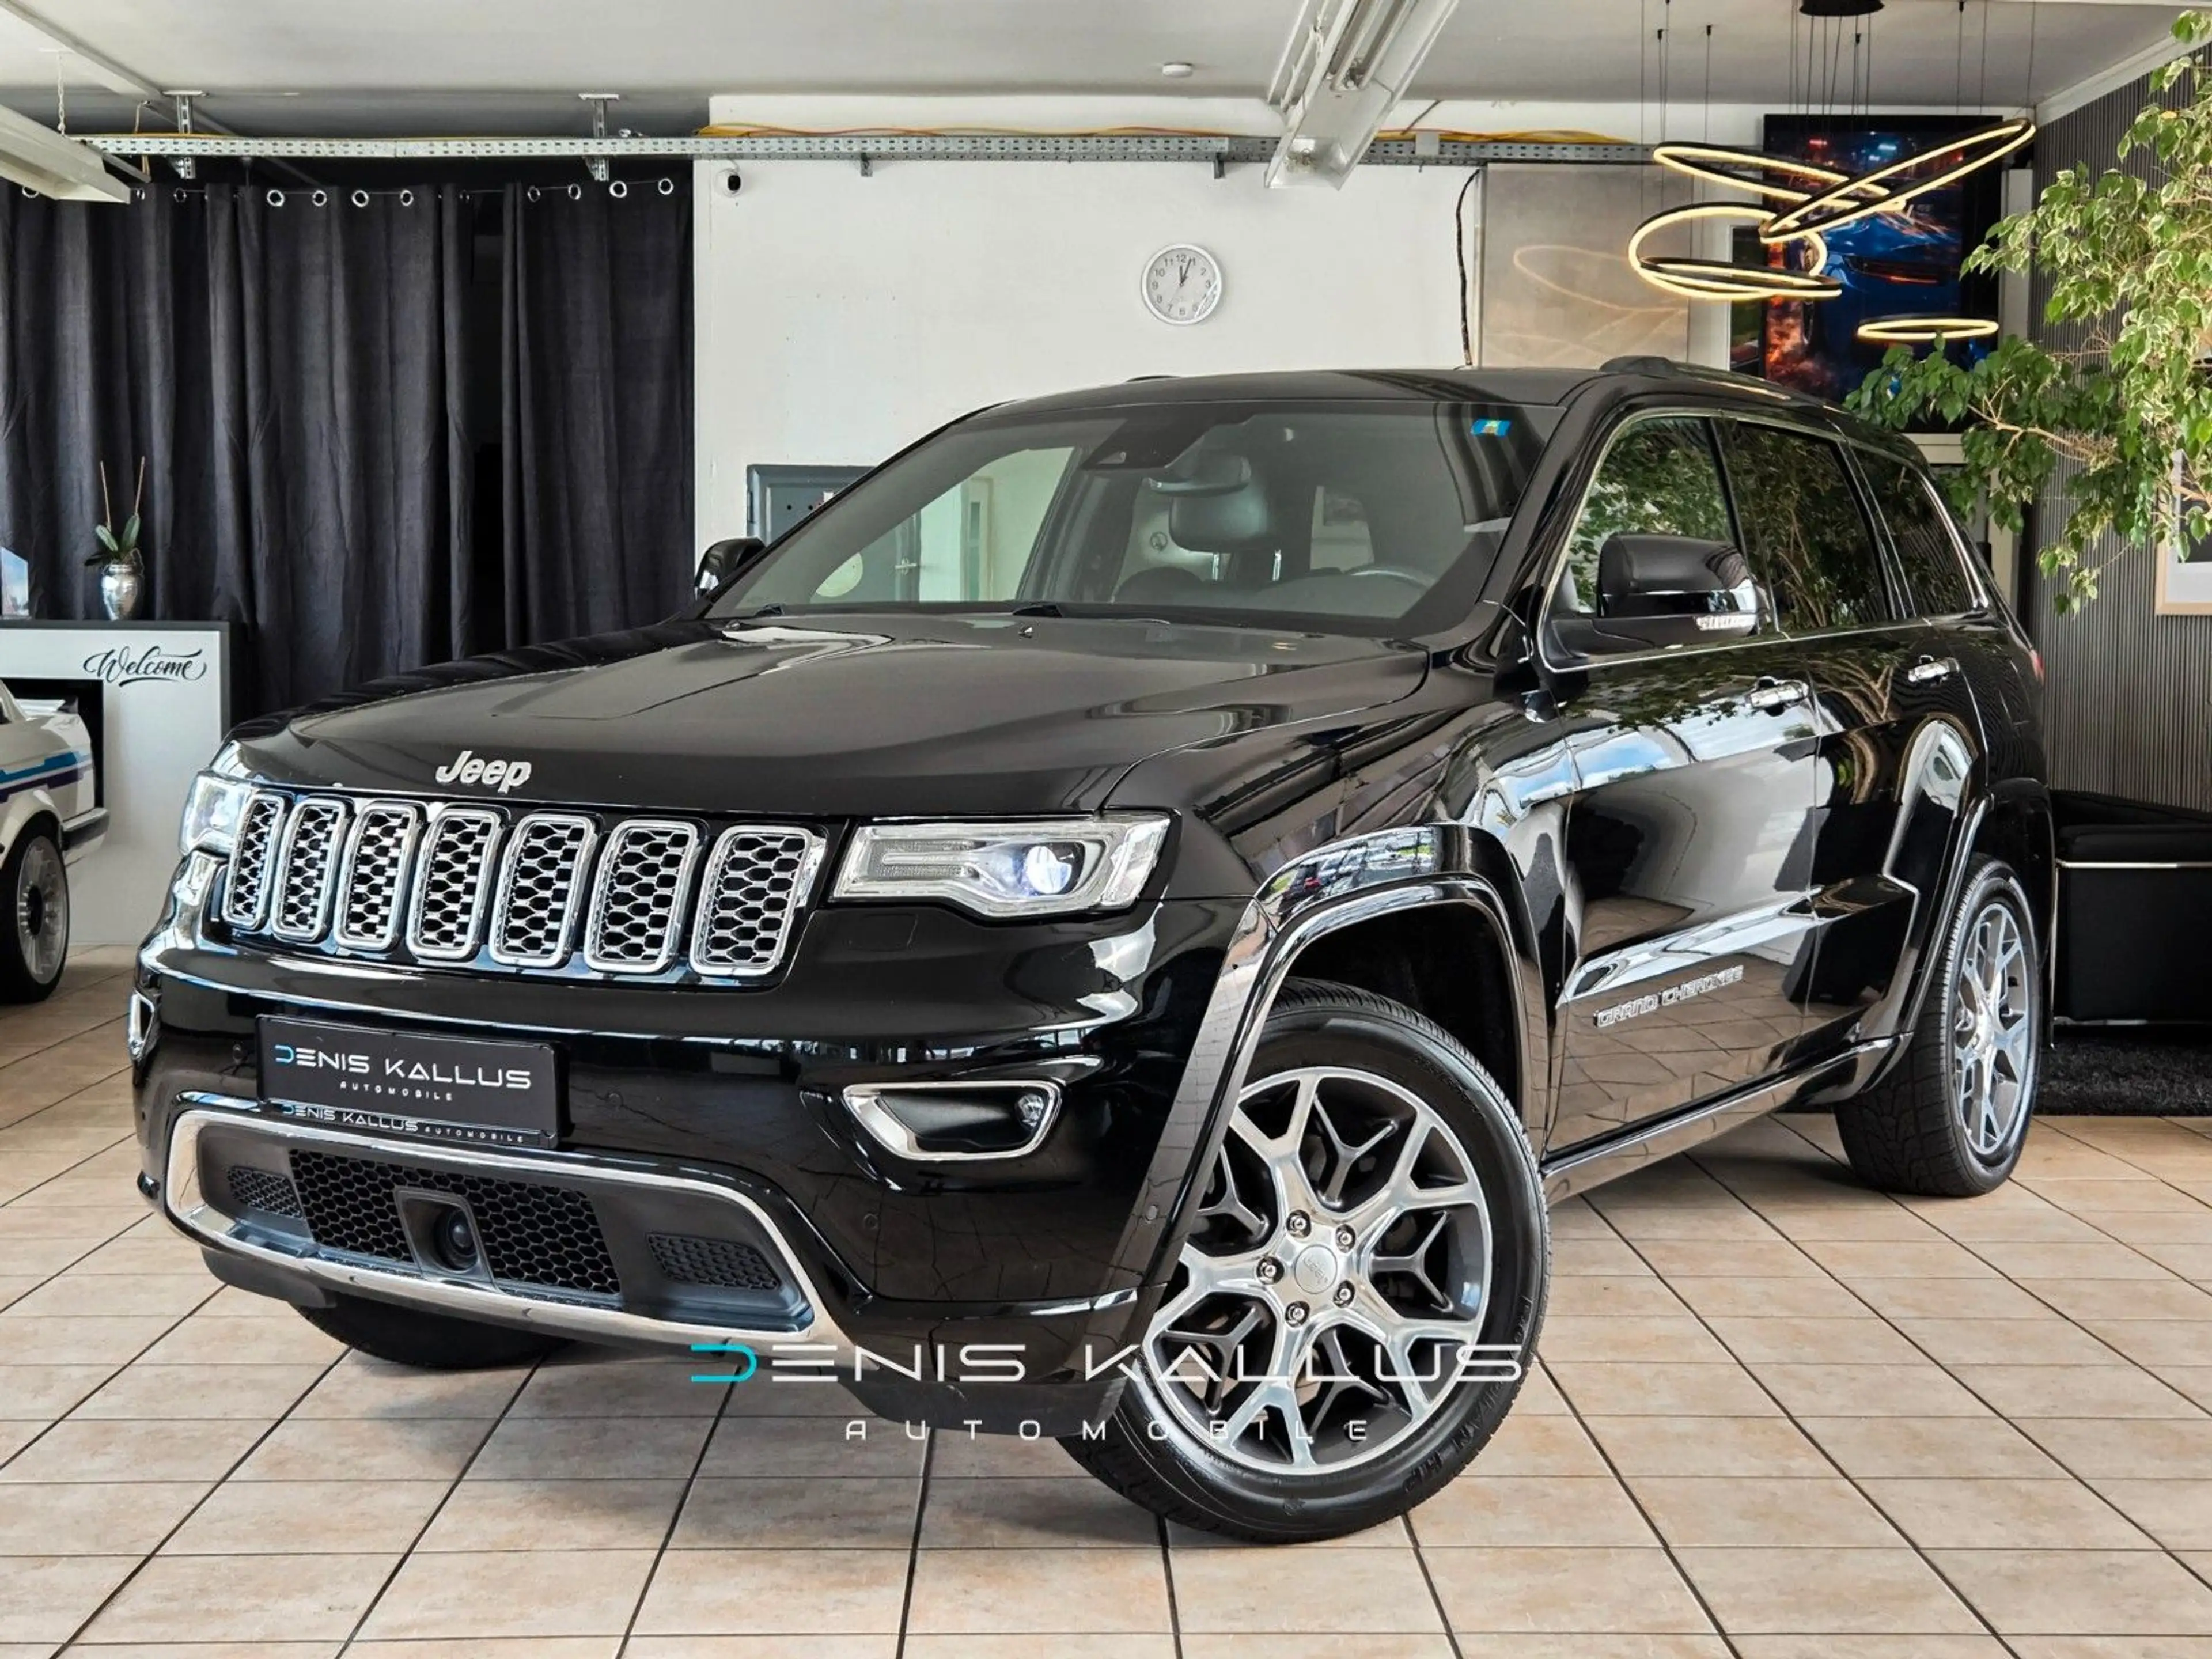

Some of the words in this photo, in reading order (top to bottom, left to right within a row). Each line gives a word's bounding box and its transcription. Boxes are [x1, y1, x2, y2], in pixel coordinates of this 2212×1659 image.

[1165, 258, 1173, 266] 11
[1176, 253, 1187, 263] 12
[1154, 268, 1165, 277] 10
[1152, 280, 1159, 290] 9
[1205, 279, 1211, 289] 3
[83, 645, 207, 683] Welcome
[435, 750, 532, 794] Jeep
[1594, 993, 1658, 1028] GRAND
[1661, 964, 1744, 1006] CHEROKEE
[274, 1044, 370, 1074] DENIS
[384, 1058, 532, 1090] KALLUS
[340, 1080, 453, 1101] AUTOMOBILE
[282, 1104, 336, 1122] DENIS
[342, 1112, 419, 1132] KALLUS
[424, 1126, 524, 1144] AUTOMOBILE
